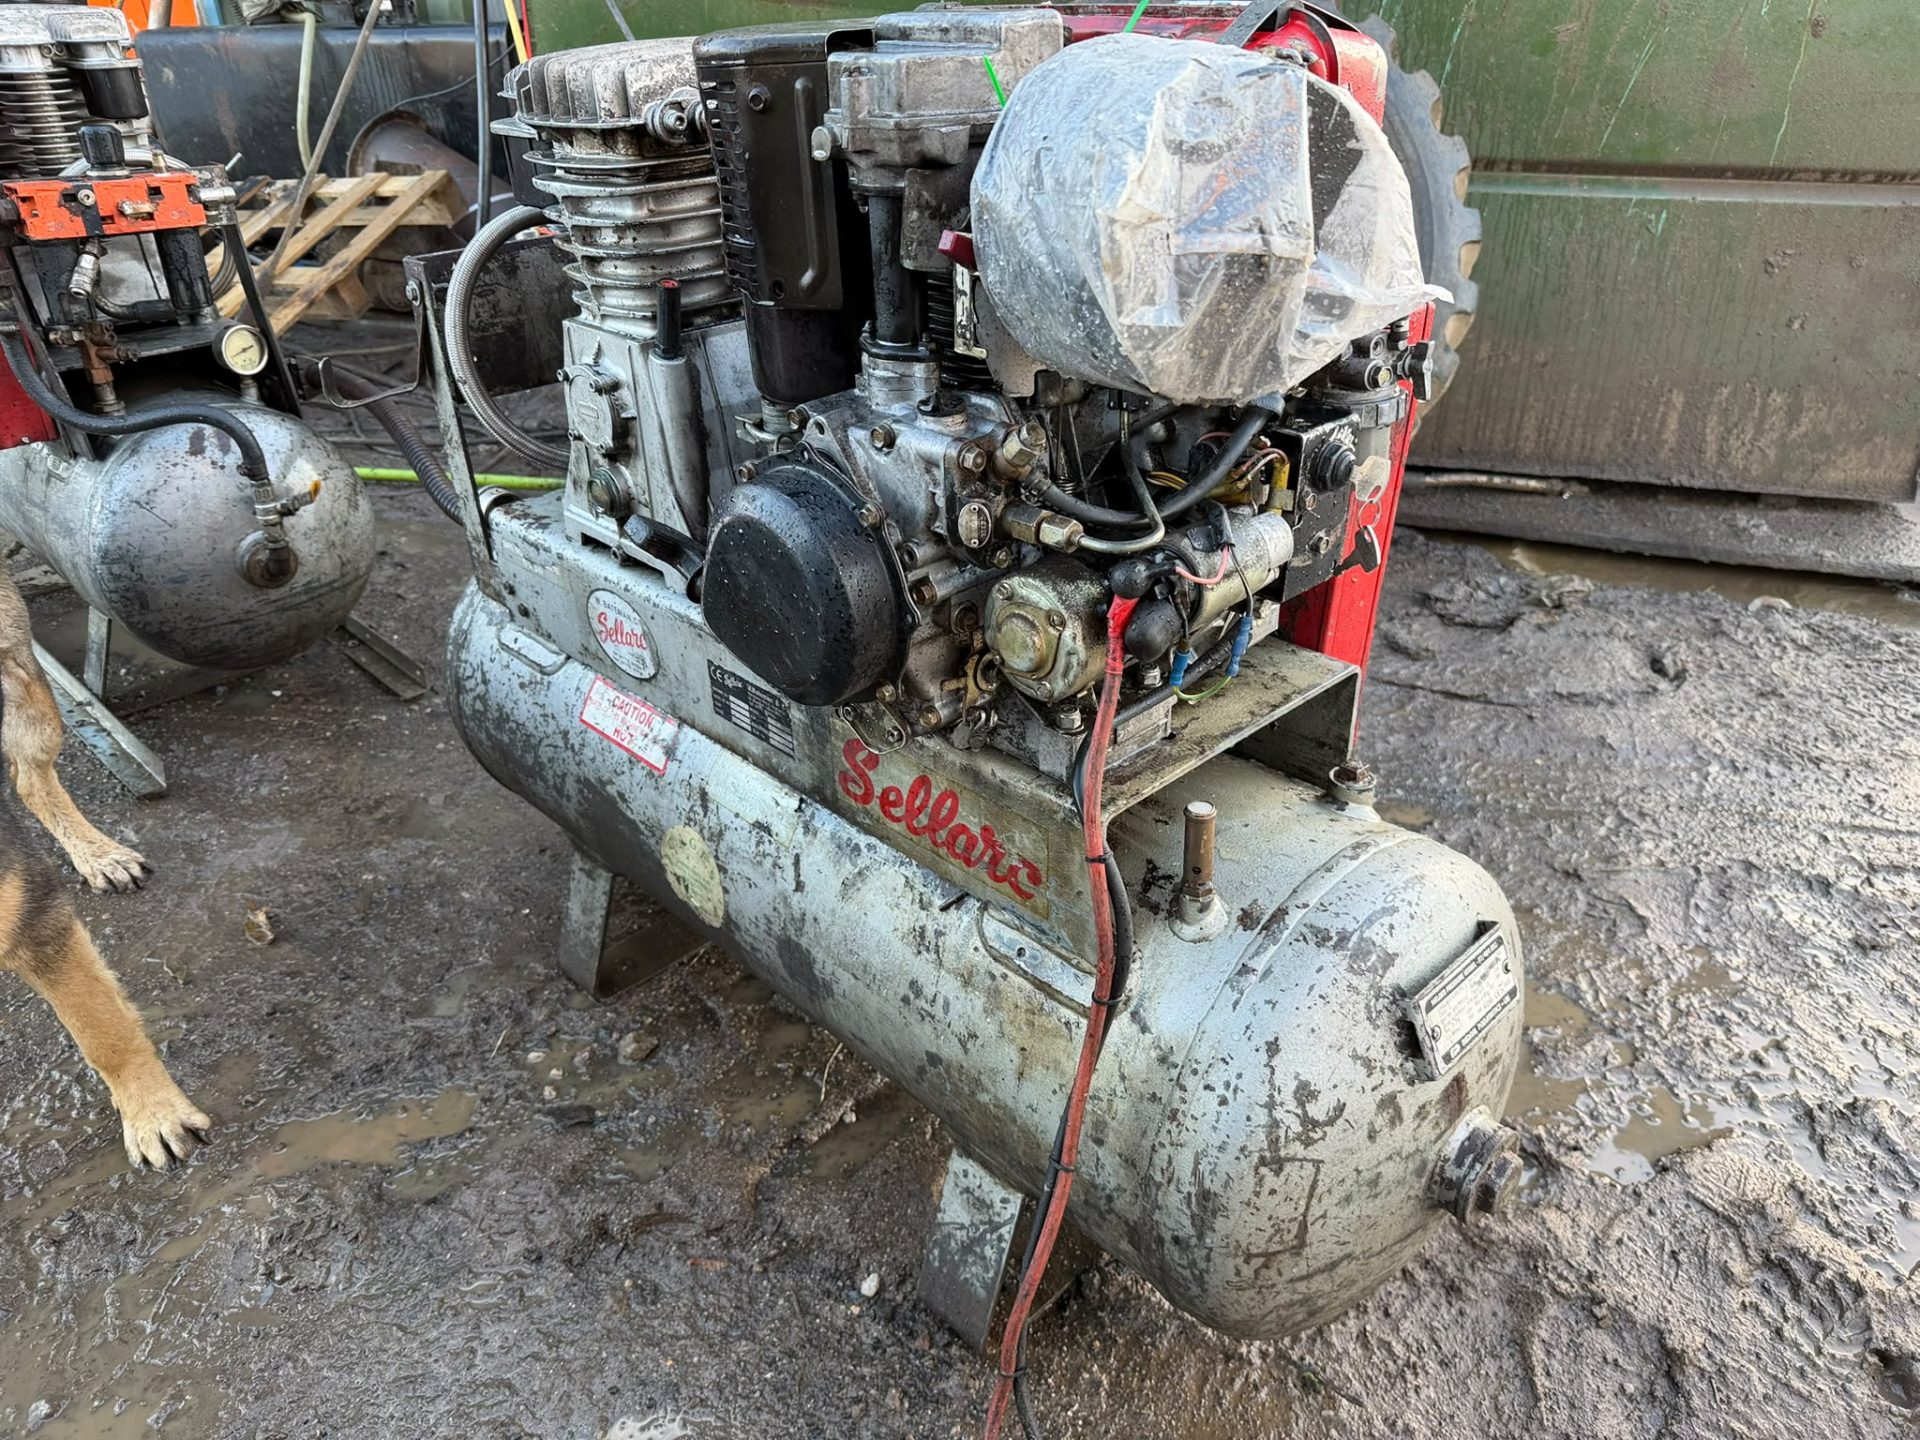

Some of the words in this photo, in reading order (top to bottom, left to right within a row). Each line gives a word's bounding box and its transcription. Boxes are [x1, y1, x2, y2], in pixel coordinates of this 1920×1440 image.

[597, 611, 648, 650] Sellarc
[612, 695, 654, 729] CAUTION
[838, 738, 1042, 900] Sellarc
